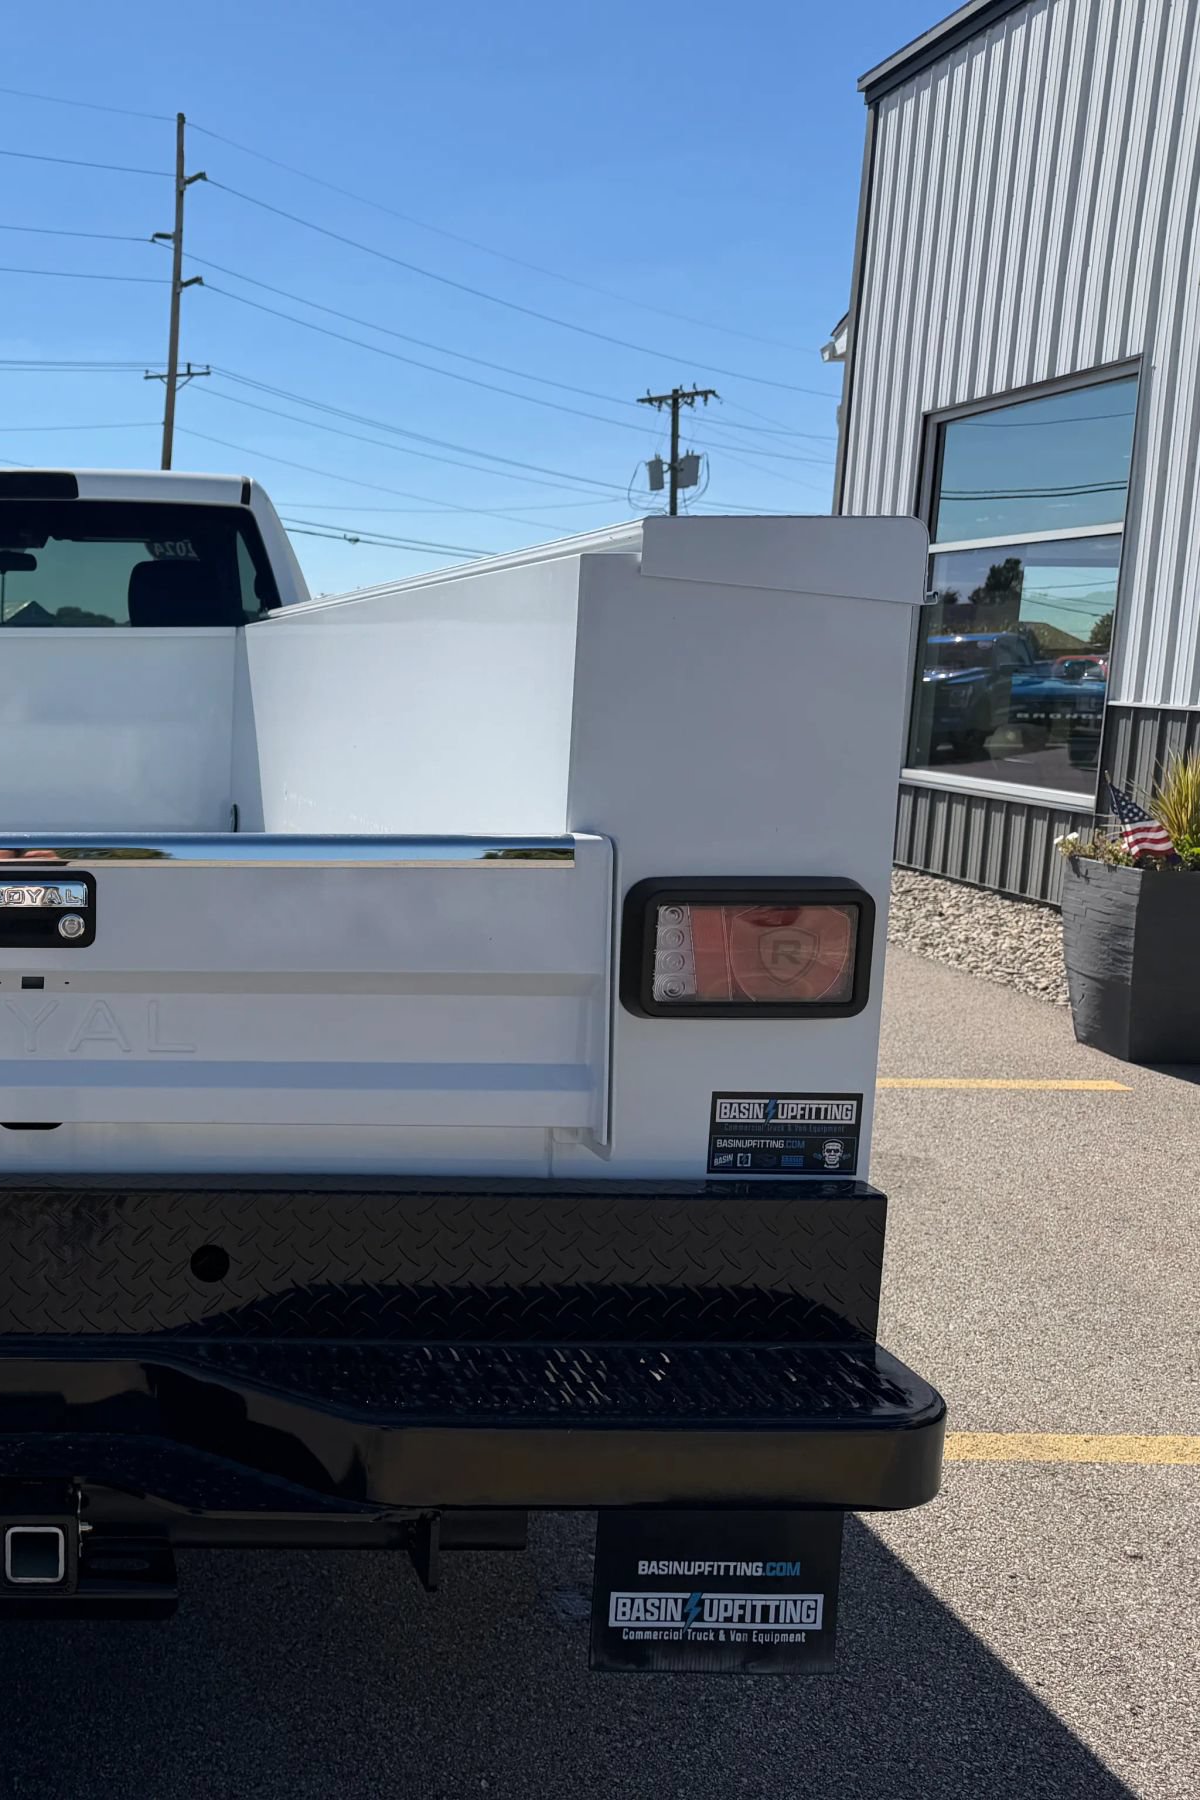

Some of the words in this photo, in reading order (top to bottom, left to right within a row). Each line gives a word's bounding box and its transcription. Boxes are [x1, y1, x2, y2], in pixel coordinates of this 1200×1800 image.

[771, 940, 802, 965] R
[720, 1102, 764, 1119] BASIN
[778, 1103, 852, 1120] UPFITTING
[638, 1560, 800, 1576] BASINUPFITTING.COM
[616, 1598, 682, 1621] BASIN
[703, 1599, 816, 1623] UPFITTING
[622, 1628, 683, 1640] Commercial
[687, 1629, 714, 1641] Truck
[718, 1630, 725, 1641] &
[730, 1631, 748, 1642] Van
[752, 1631, 806, 1644] Equipment
